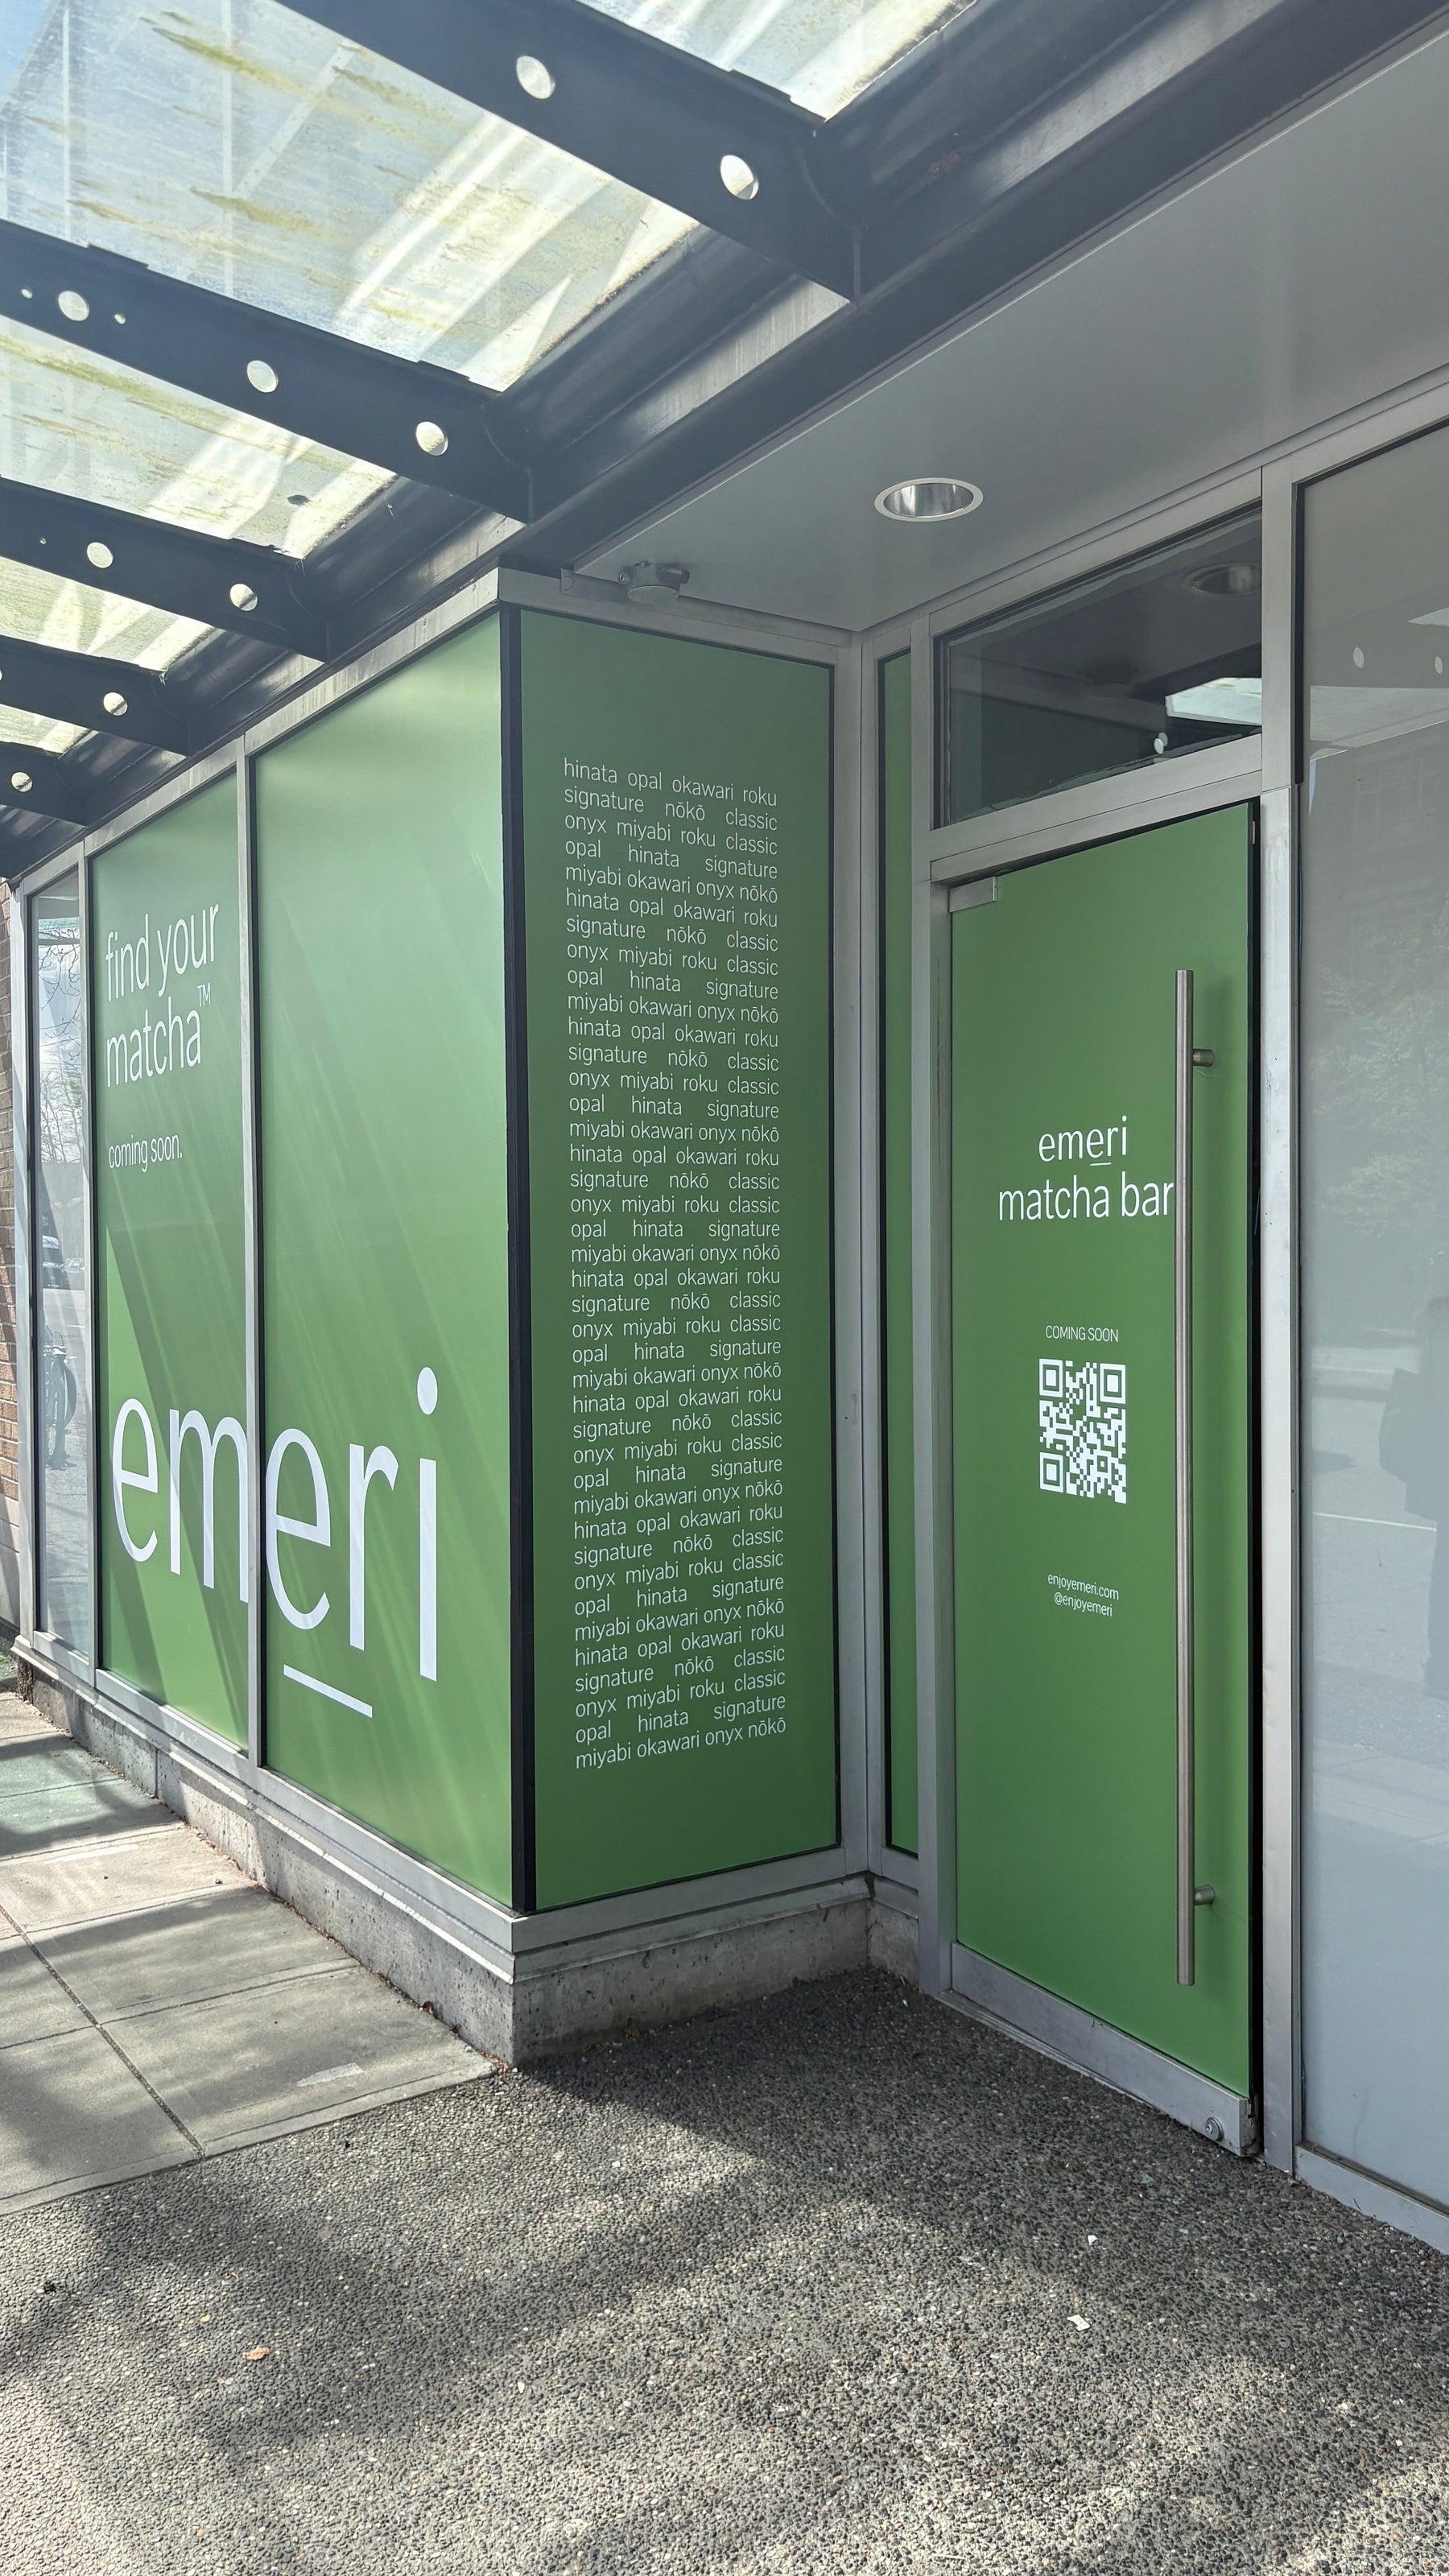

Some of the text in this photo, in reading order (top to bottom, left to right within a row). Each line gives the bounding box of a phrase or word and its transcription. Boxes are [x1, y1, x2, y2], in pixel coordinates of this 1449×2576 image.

[564, 758, 776, 806] hinata opal okawari roku
[564, 786, 644, 812] signature
[726, 807, 777, 831] classic
[565, 815, 777, 855] onyx miyabi roku classic
[565, 840, 777, 879] opal hinata signature
[566, 864, 621, 886] miyabi
[627, 869, 690, 894] okawari
[696, 882, 734, 900] onyx
[567, 887, 777, 927] hinata opal okawari roku
[567, 914, 645, 939] signature
[727, 930, 778, 952] classic
[105, 903, 218, 1001] find your
[568, 944, 778, 976] onyx miyabi roku classic
[568, 967, 778, 1000] opal hinata signature
[568, 992, 622, 1013] miyabi
[629, 996, 691, 1018] okawari
[697, 1005, 735, 1022] onyx
[568, 1016, 778, 1047] hinata opal okawari roku
[568, 1042, 646, 1066] signature
[728, 1051, 778, 1071] classic
[569, 1071, 778, 1095] onyx miyabi roku classic
[569, 1093, 778, 1121] opal hinata signature
[570, 1119, 624, 1140] miyabi
[630, 1121, 692, 1140] okawari
[699, 1127, 736, 1144] onyx
[1038, 1115, 1127, 1162] emeri
[109, 1134, 183, 1173] coming soon.
[570, 1143, 778, 1166] hinata opal okawari roku
[571, 1169, 648, 1191] signature
[729, 1171, 779, 1189] classic
[999, 1170, 1174, 1220] matcha bar
[571, 1195, 779, 1216] onyx miyabi roku classic
[571, 1219, 780, 1241] opal hinata signature
[572, 1244, 625, 1265] miyabi
[632, 1244, 694, 1261] okawari
[700, 1248, 737, 1264] onyx
[572, 1266, 779, 1290] hinata opal okawari roku
[572, 1294, 650, 1317] signature
[730, 1290, 780, 1308] classic
[572, 1314, 780, 1340] onyx miyabi roku classic
[1046, 1325, 1119, 1342] COMING SOON
[572, 1339, 781, 1366] opal hinata signature
[573, 1368, 627, 1390] miyabi
[634, 1364, 695, 1385] okawari
[701, 1367, 739, 1383] onyx
[573, 1385, 781, 1413] hinata opal okawari roku
[573, 1418, 651, 1442] signature
[731, 1408, 782, 1427] classic
[573, 1431, 782, 1465] onyx miyabi roku classic
[574, 1457, 782, 1492] opal hinata signature
[574, 1492, 628, 1516] miyabi
[634, 1485, 696, 1508] okawari
[702, 1486, 740, 1503] onyx
[113, 1367, 438, 1682] emeri
[574, 1503, 782, 1539] hinata opal okawari roku
[574, 1542, 652, 1567] signature
[733, 1526, 783, 1546] classic
[575, 1550, 783, 1591] onyx miyabi roku classic
[1047, 1574, 1119, 1600] enjoyemeri.com
[575, 1576, 783, 1618] opal hinata signature
[1054, 1591, 1113, 1616] @enjoyemeri
[576, 1616, 630, 1641] miyabi
[636, 1608, 698, 1633] okawari
[704, 1606, 741, 1624] onyx
[576, 1621, 784, 1666] hinata opal okawari roku
[576, 1667, 654, 1695] signature
[734, 1645, 785, 1667] classic
[576, 1669, 785, 1718] onyx miyabi roku classic
[576, 1696, 785, 1745] opal hinata signature
[576, 1742, 630, 1769] miyabi
[637, 1730, 699, 1757] okawari
[705, 1727, 743, 1745] onyx
